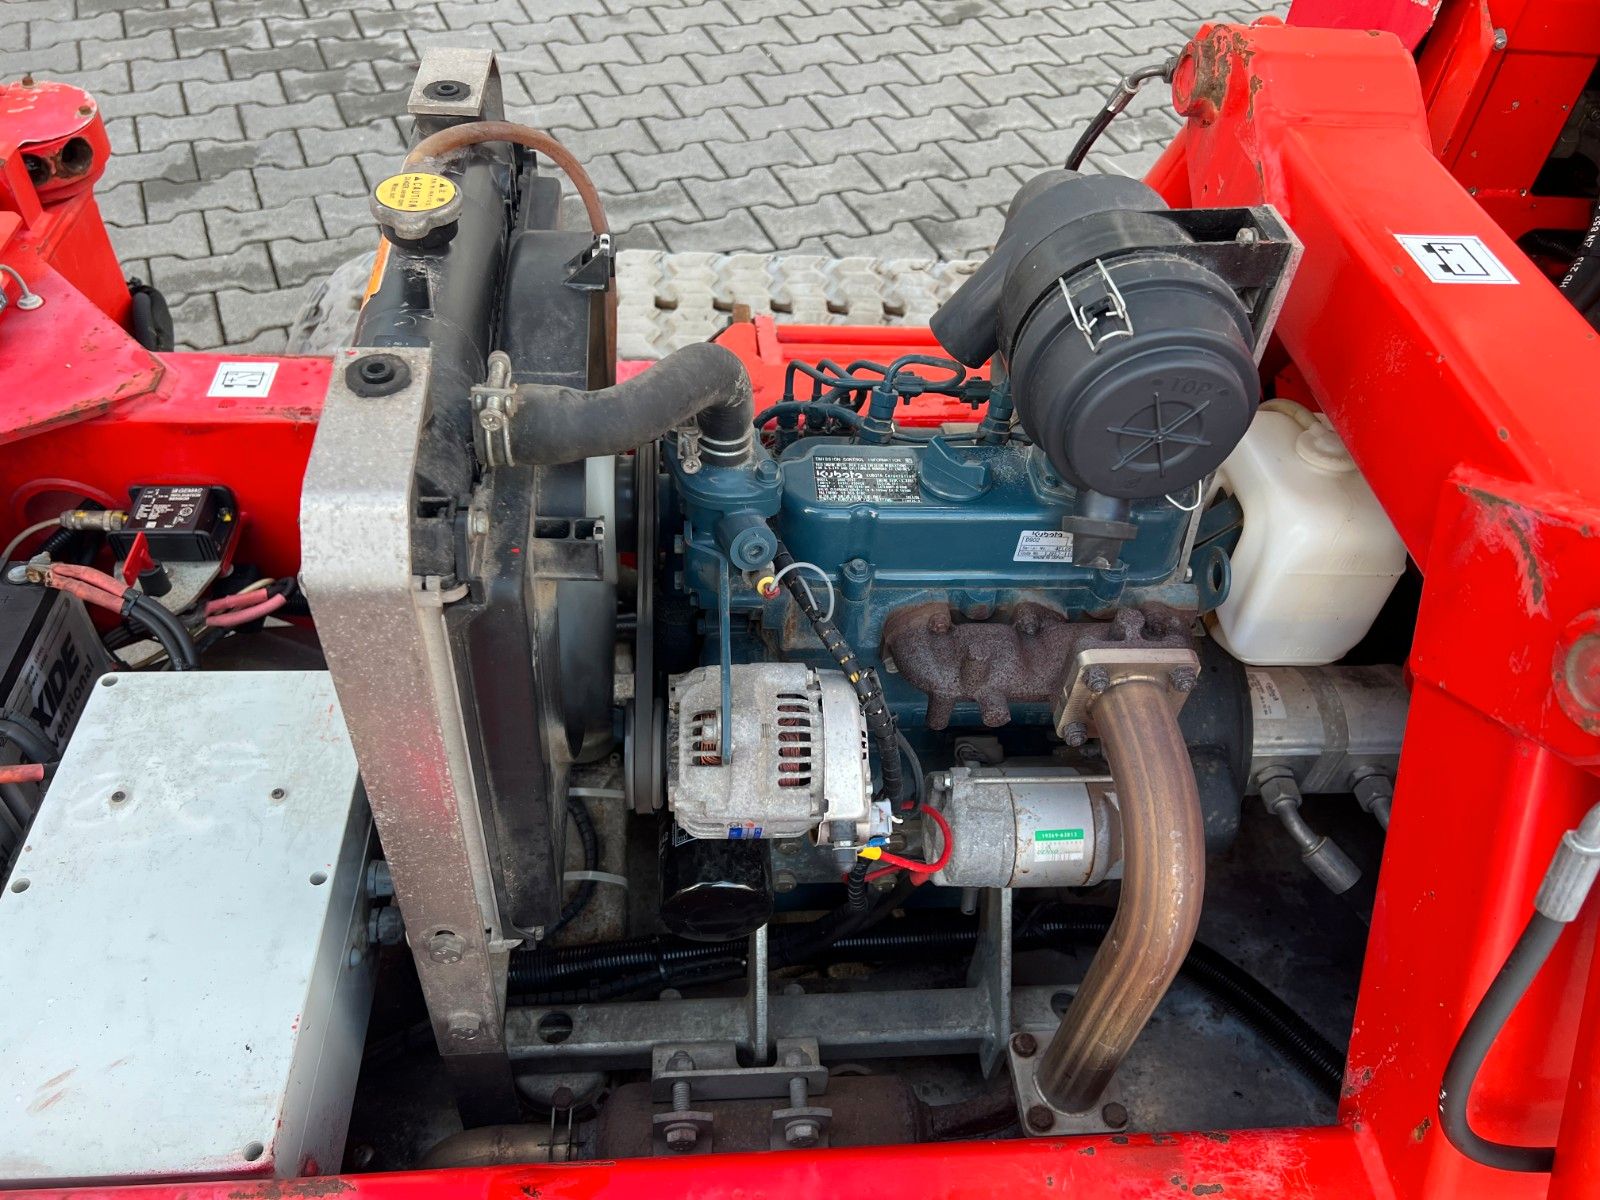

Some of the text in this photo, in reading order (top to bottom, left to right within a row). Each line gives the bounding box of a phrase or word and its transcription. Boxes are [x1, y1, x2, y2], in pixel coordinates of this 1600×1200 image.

[408, 182, 422, 208] CAUTION
[1559, 274, 1573, 288] HD
[1584, 234, 1596, 248] EN
[1170, 377, 1214, 396] TOP
[816, 470, 863, 479] Kubota
[30, 631, 80, 730] XIDE
[55, 653, 95, 748] ventional
